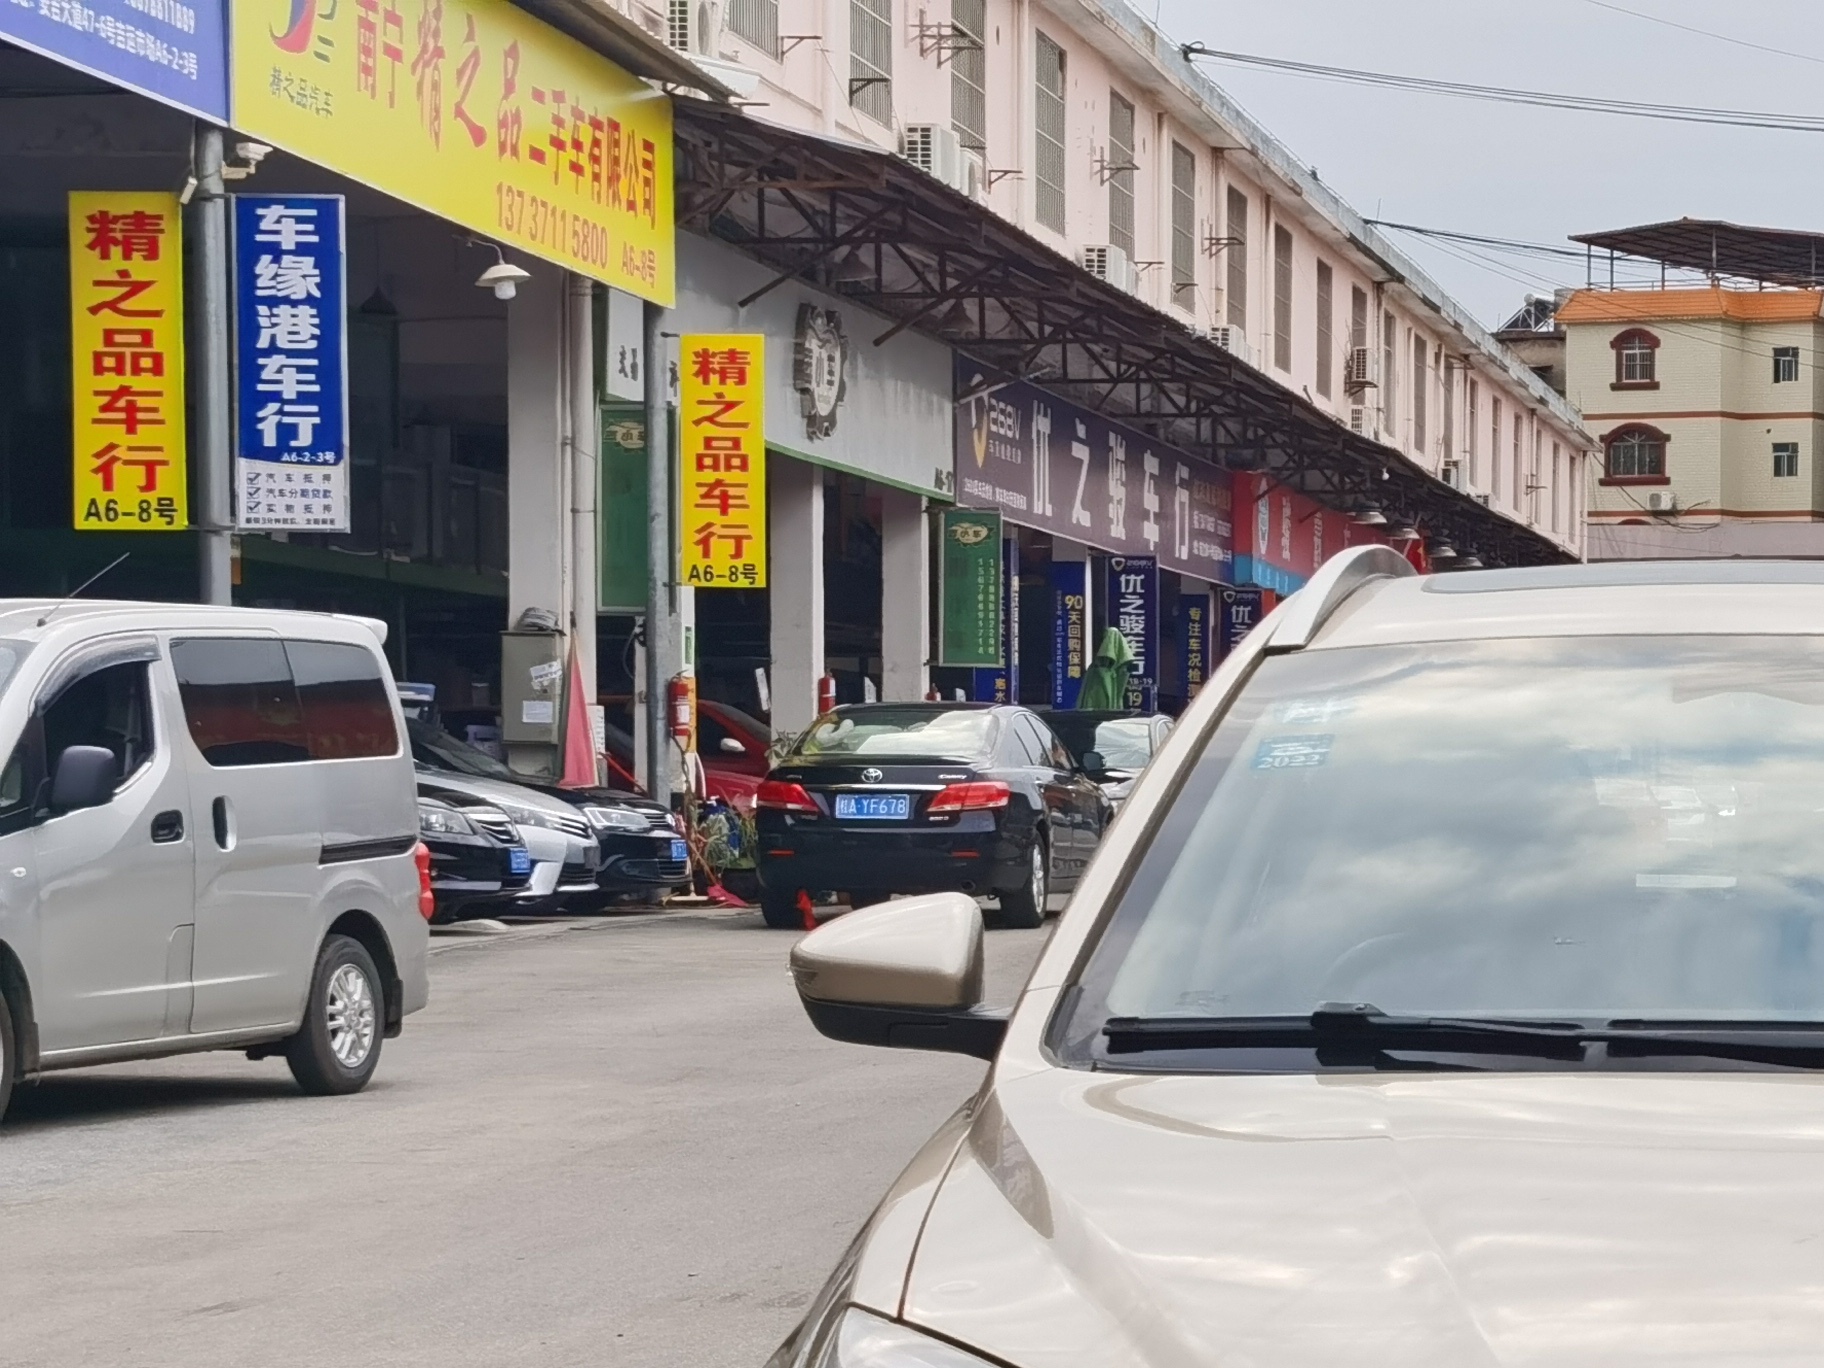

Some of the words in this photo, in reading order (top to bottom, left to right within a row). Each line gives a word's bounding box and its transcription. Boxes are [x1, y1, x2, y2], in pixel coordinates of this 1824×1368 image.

[86, 209, 171, 493] 精之品车行
[254, 204, 321, 448] 车缘港车行
[83, 499, 178, 525] A6-8号
[280, 451, 336, 464] A6-2-3号
[691, 347, 754, 560] 精之品车行
[687, 564, 758, 586] A6-8号
